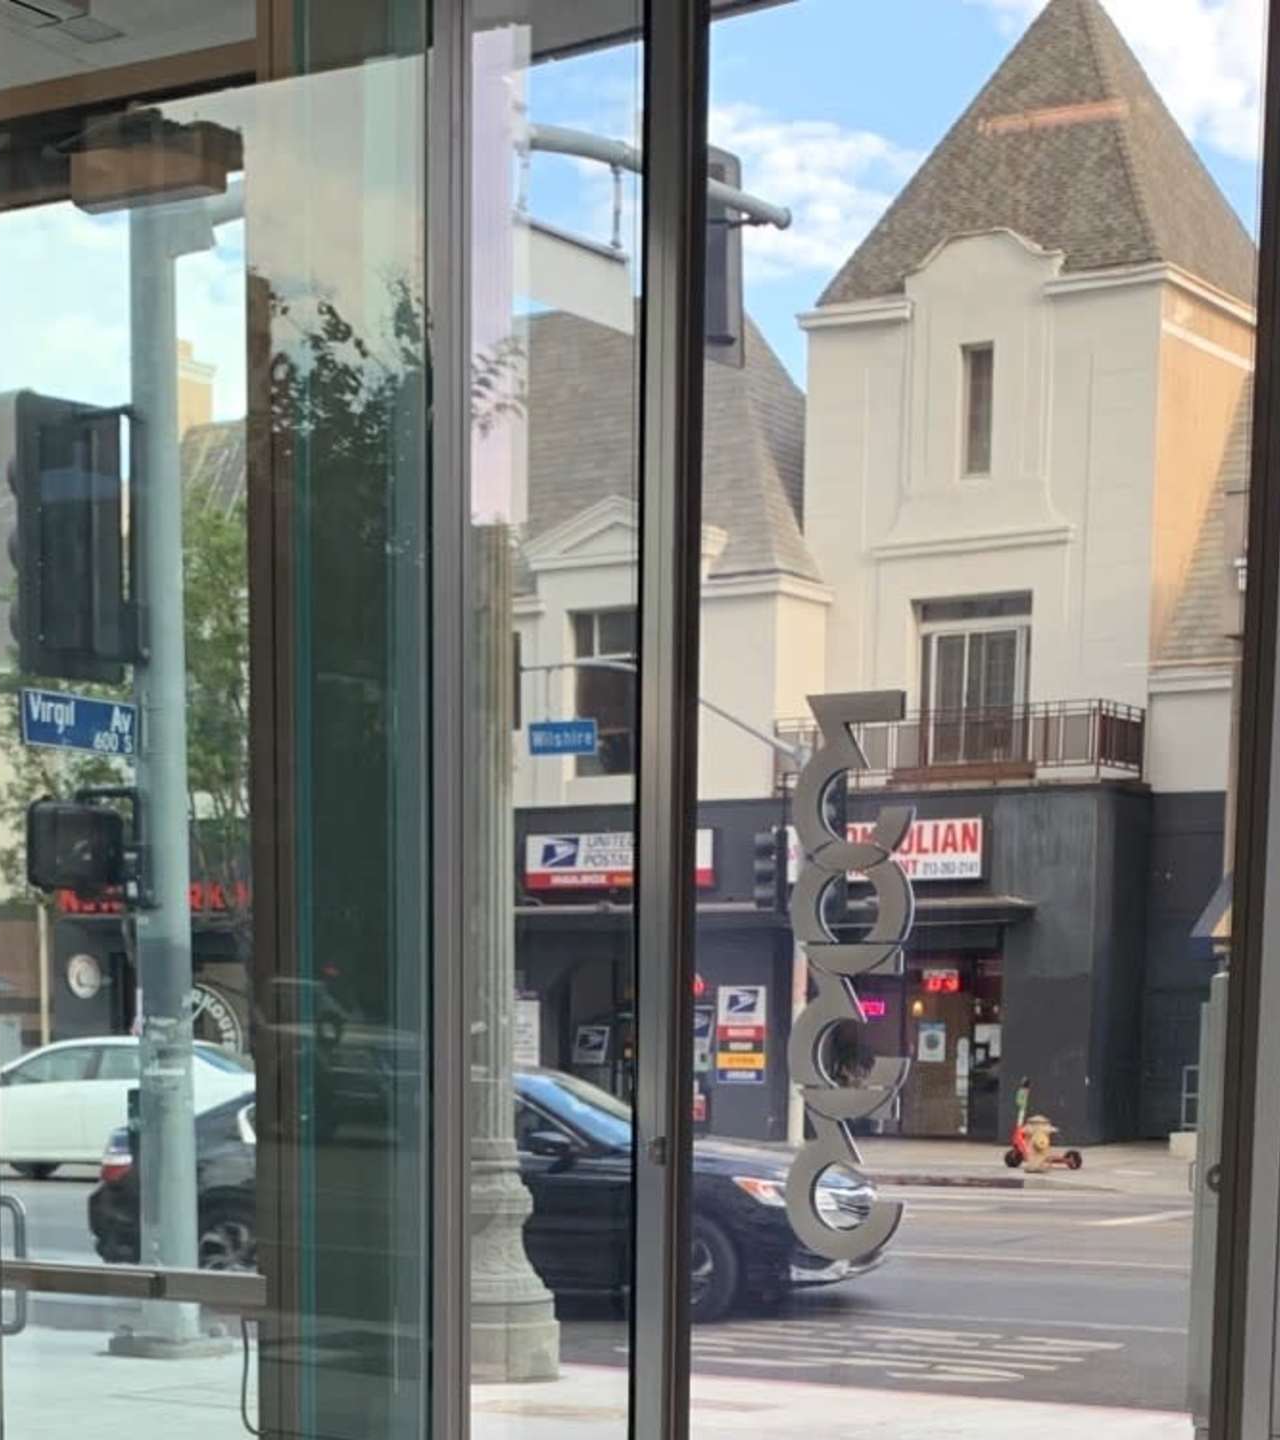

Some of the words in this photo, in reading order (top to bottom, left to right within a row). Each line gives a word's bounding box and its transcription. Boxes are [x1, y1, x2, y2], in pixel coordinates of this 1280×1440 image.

[29, 693, 75, 735] Virgil
[111, 705, 132, 733] Av
[94, 731, 119, 752] 600
[124, 734, 132, 753] S
[531, 729, 593, 748] Wilshire
